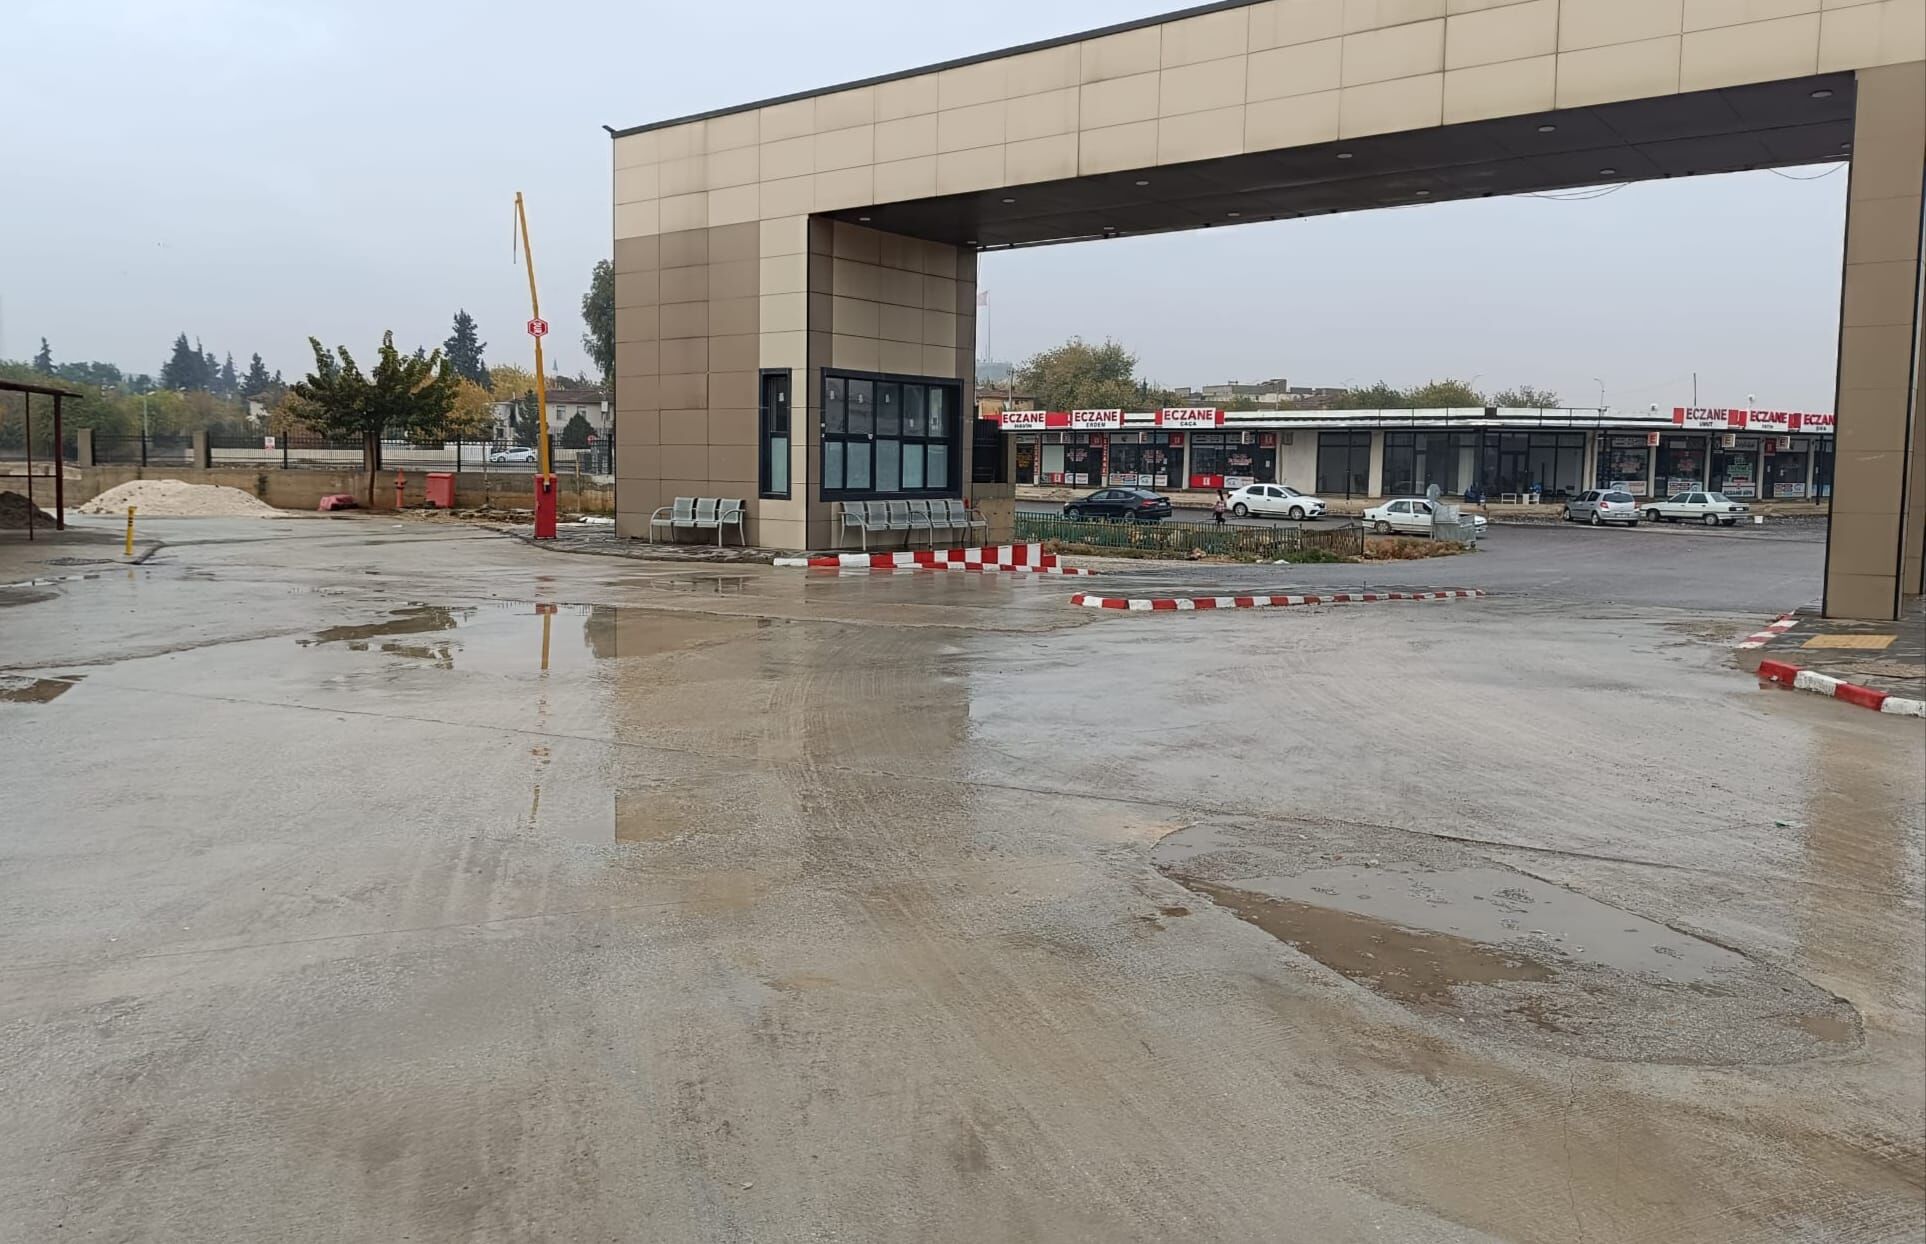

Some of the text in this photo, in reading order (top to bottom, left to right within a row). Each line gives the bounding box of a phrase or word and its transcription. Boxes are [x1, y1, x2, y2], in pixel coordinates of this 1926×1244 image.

[1003, 413, 1044, 423] ECZANE
[1075, 411, 1117, 421] ECZANE
[1164, 409, 1212, 420] ECZANE
[1686, 407, 1727, 420] ECZANE
[1750, 410, 1787, 423] ECZANE
[1804, 413, 1834, 425] ECZAN
